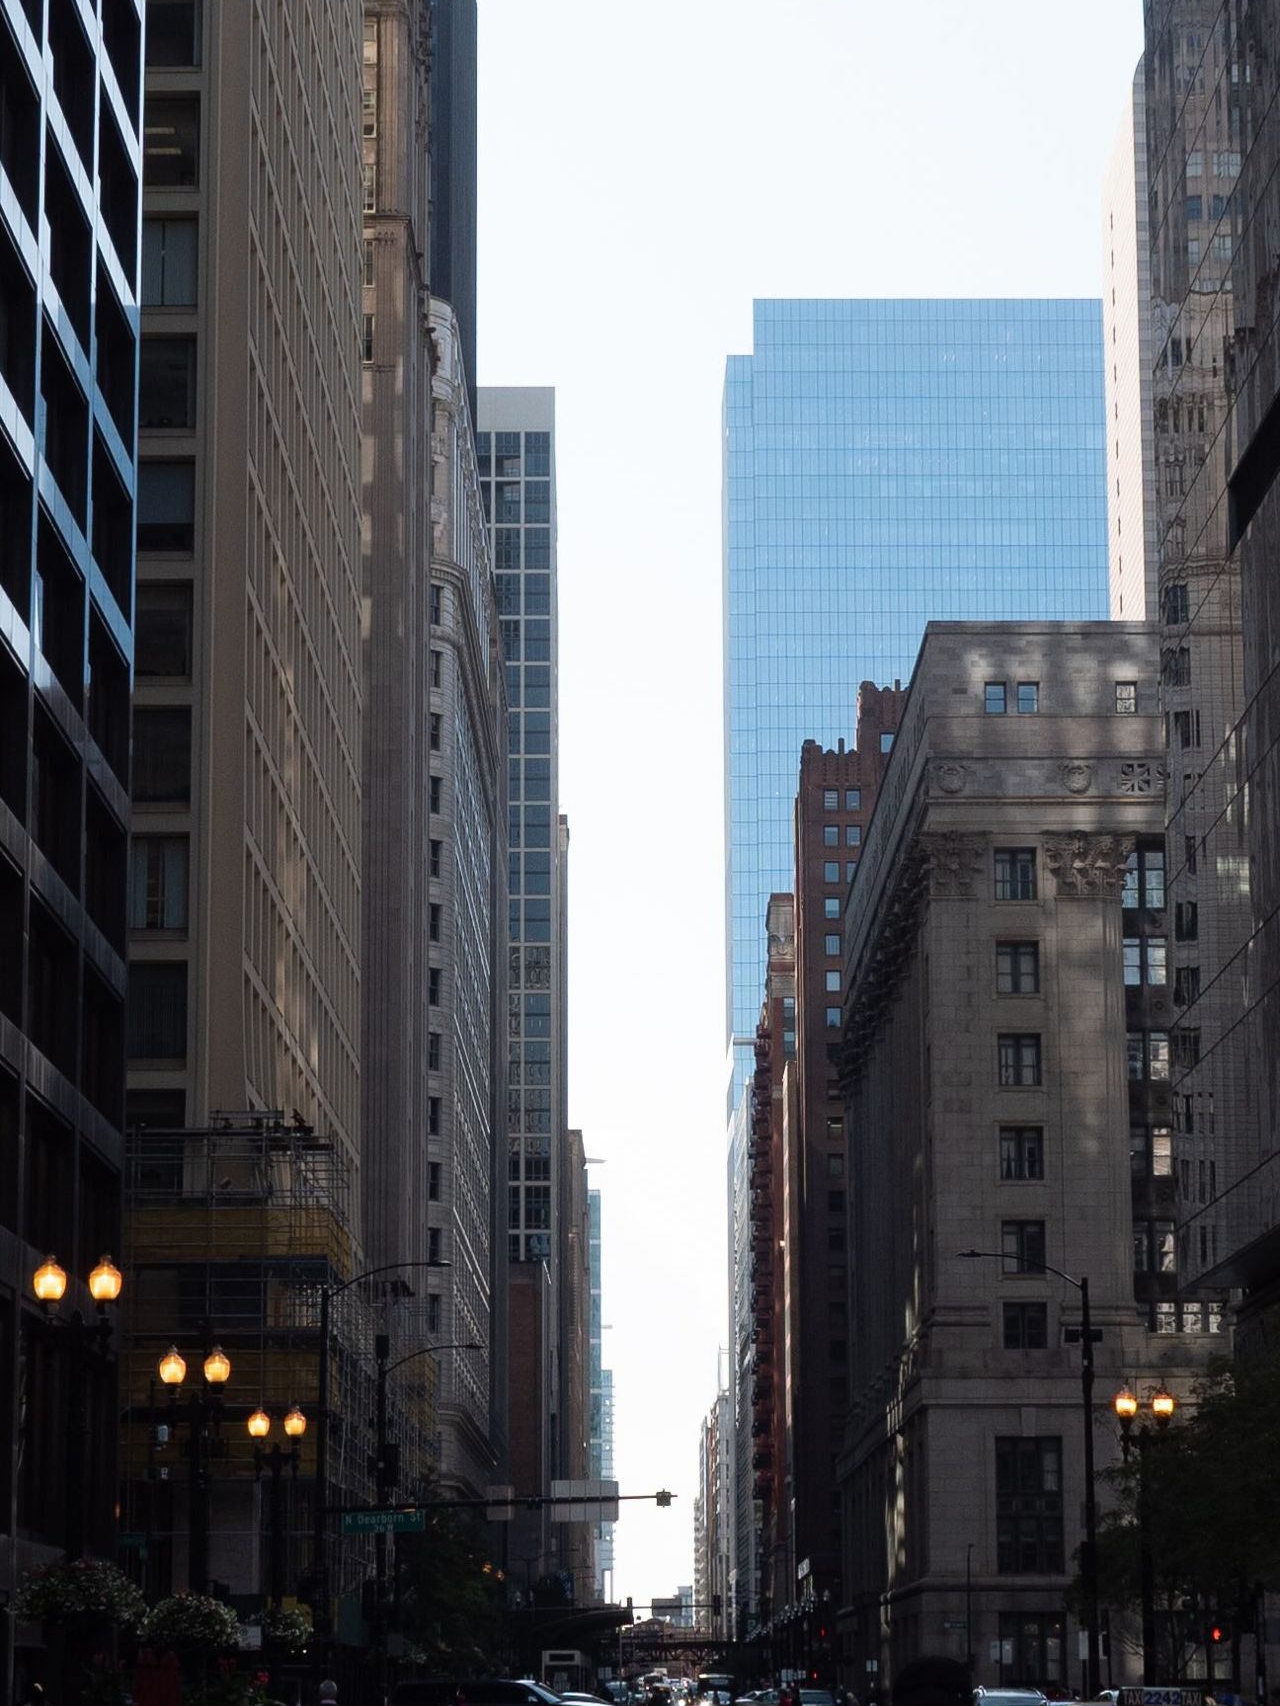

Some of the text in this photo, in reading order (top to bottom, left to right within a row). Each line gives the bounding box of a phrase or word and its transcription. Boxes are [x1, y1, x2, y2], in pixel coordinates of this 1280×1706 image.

[345, 1512, 421, 1526] N Dearborn St
[1123, 1690, 1143, 1706] TAXI
[1144, 1690, 1182, 1706] 2242
